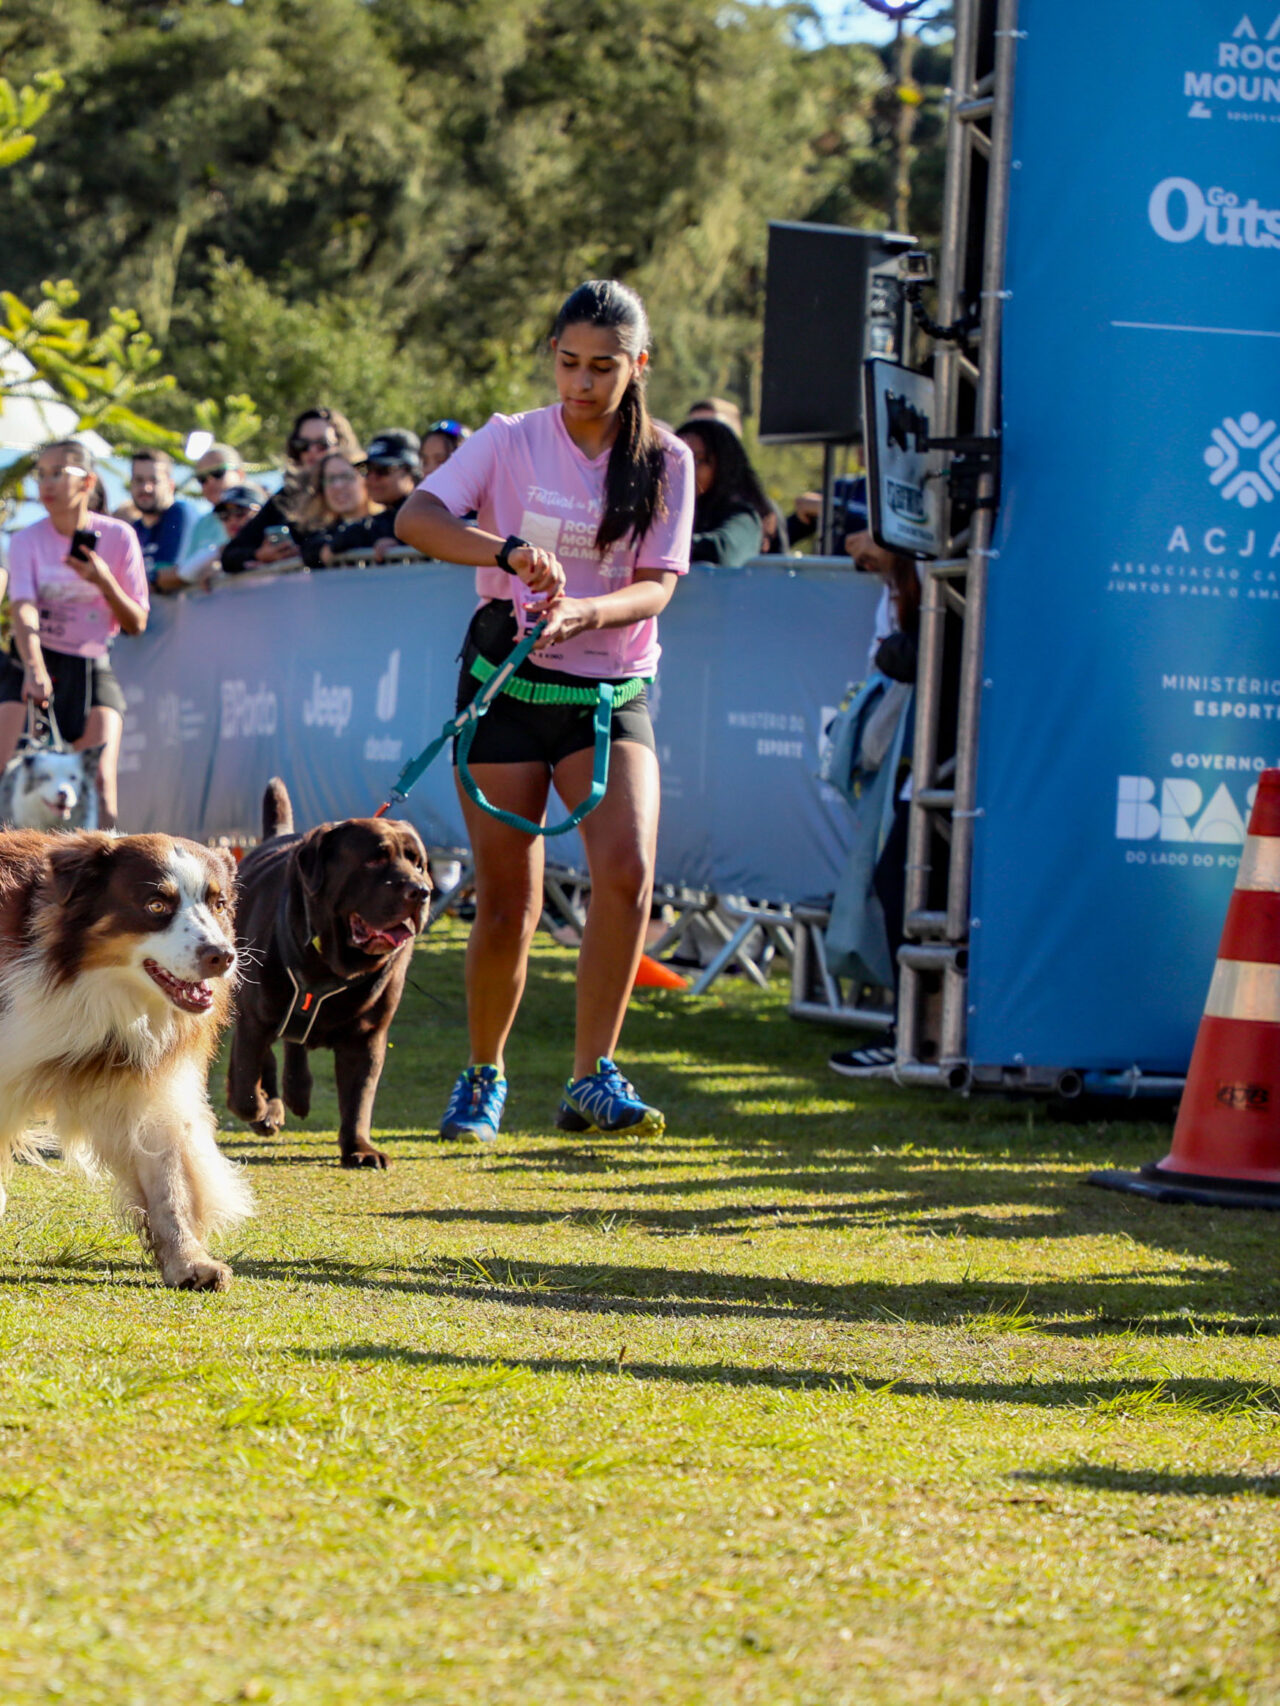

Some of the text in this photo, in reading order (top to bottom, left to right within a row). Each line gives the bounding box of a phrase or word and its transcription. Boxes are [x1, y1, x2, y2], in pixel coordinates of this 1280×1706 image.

[1207, 187, 1238, 206] Go
[1111, 561, 1240, 581] ASSOCIAÇÃO
[1107, 580, 1171, 595] JUNTOS
[1179, 584, 1220, 597] PARA
[1170, 752, 1266, 772] GOVERNO
[1125, 850, 1147, 864] DO
[1151, 852, 1189, 866] LADO
[1192, 854, 1214, 867] DO
